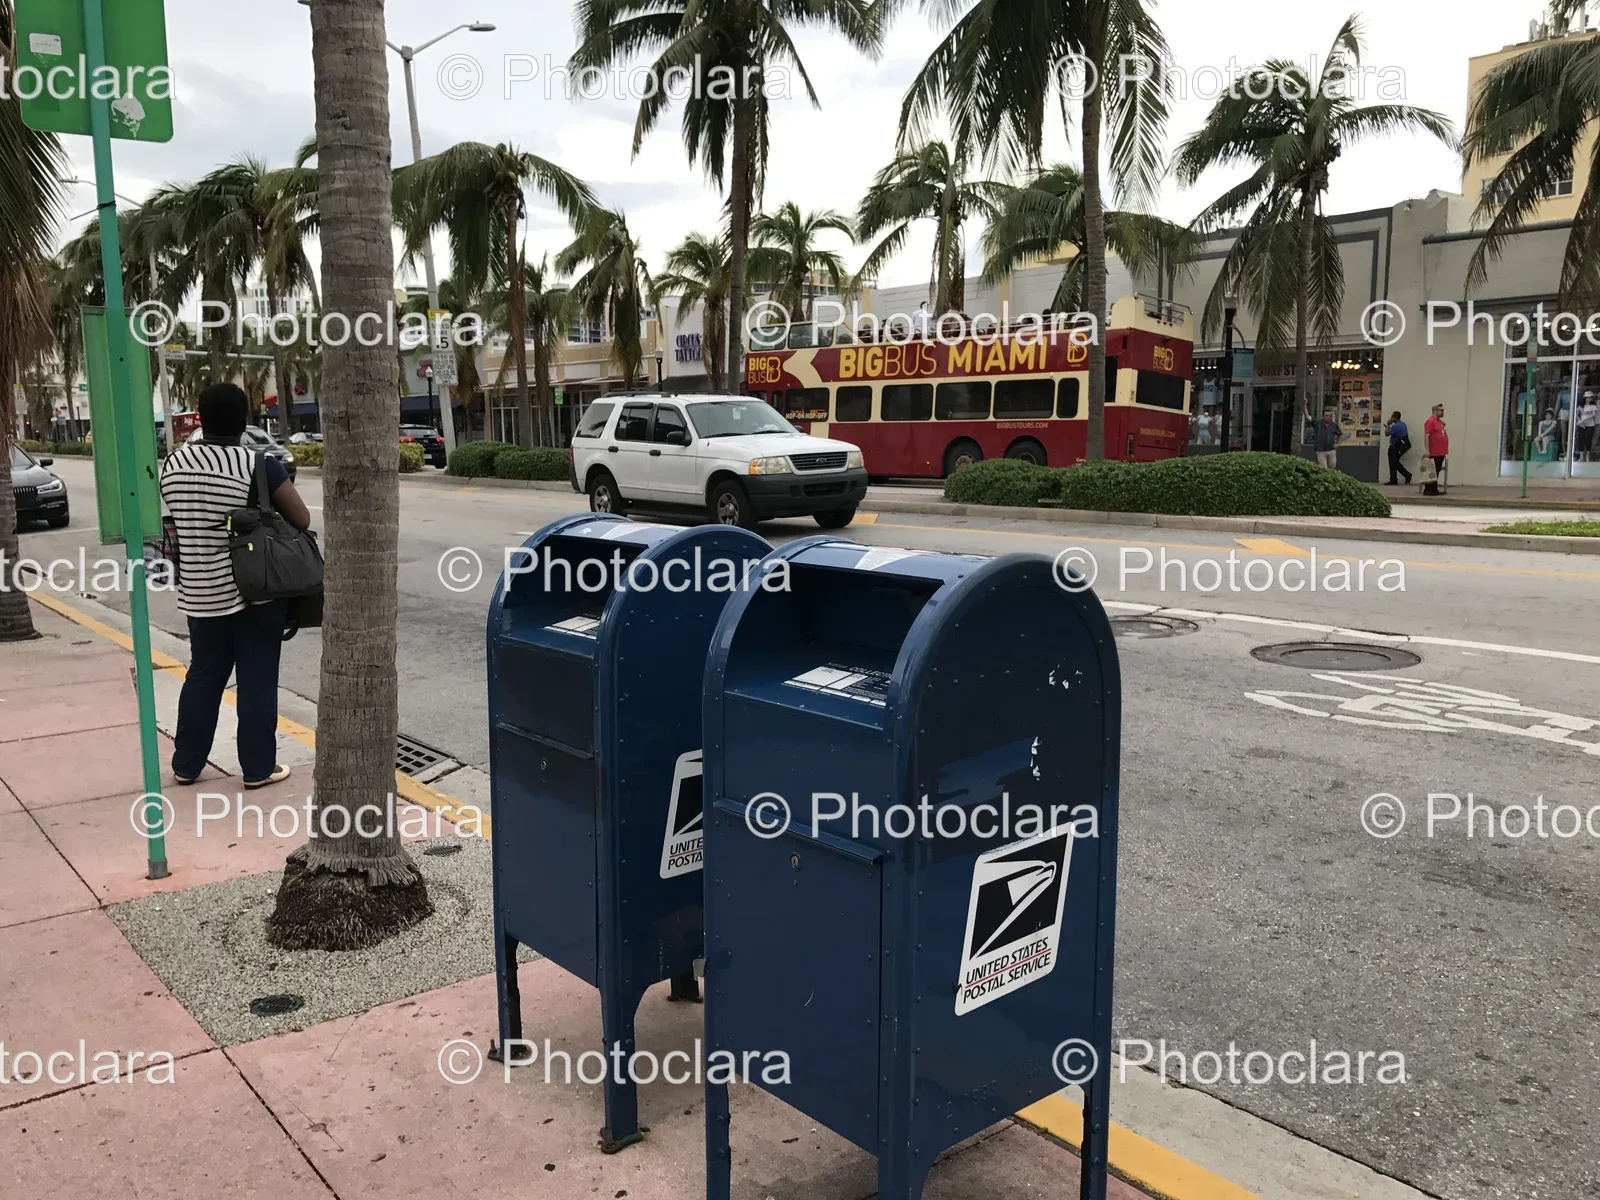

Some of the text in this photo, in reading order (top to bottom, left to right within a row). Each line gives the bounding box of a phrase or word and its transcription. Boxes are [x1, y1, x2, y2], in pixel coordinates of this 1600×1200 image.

[749, 357, 766, 371] BIG
[947, 336, 1048, 373] MIAMI
[748, 371, 766, 384] BUS
[963, 952, 1051, 1004] POSTAL SERVICE
[965, 937, 1048, 985] UNITED STATES
